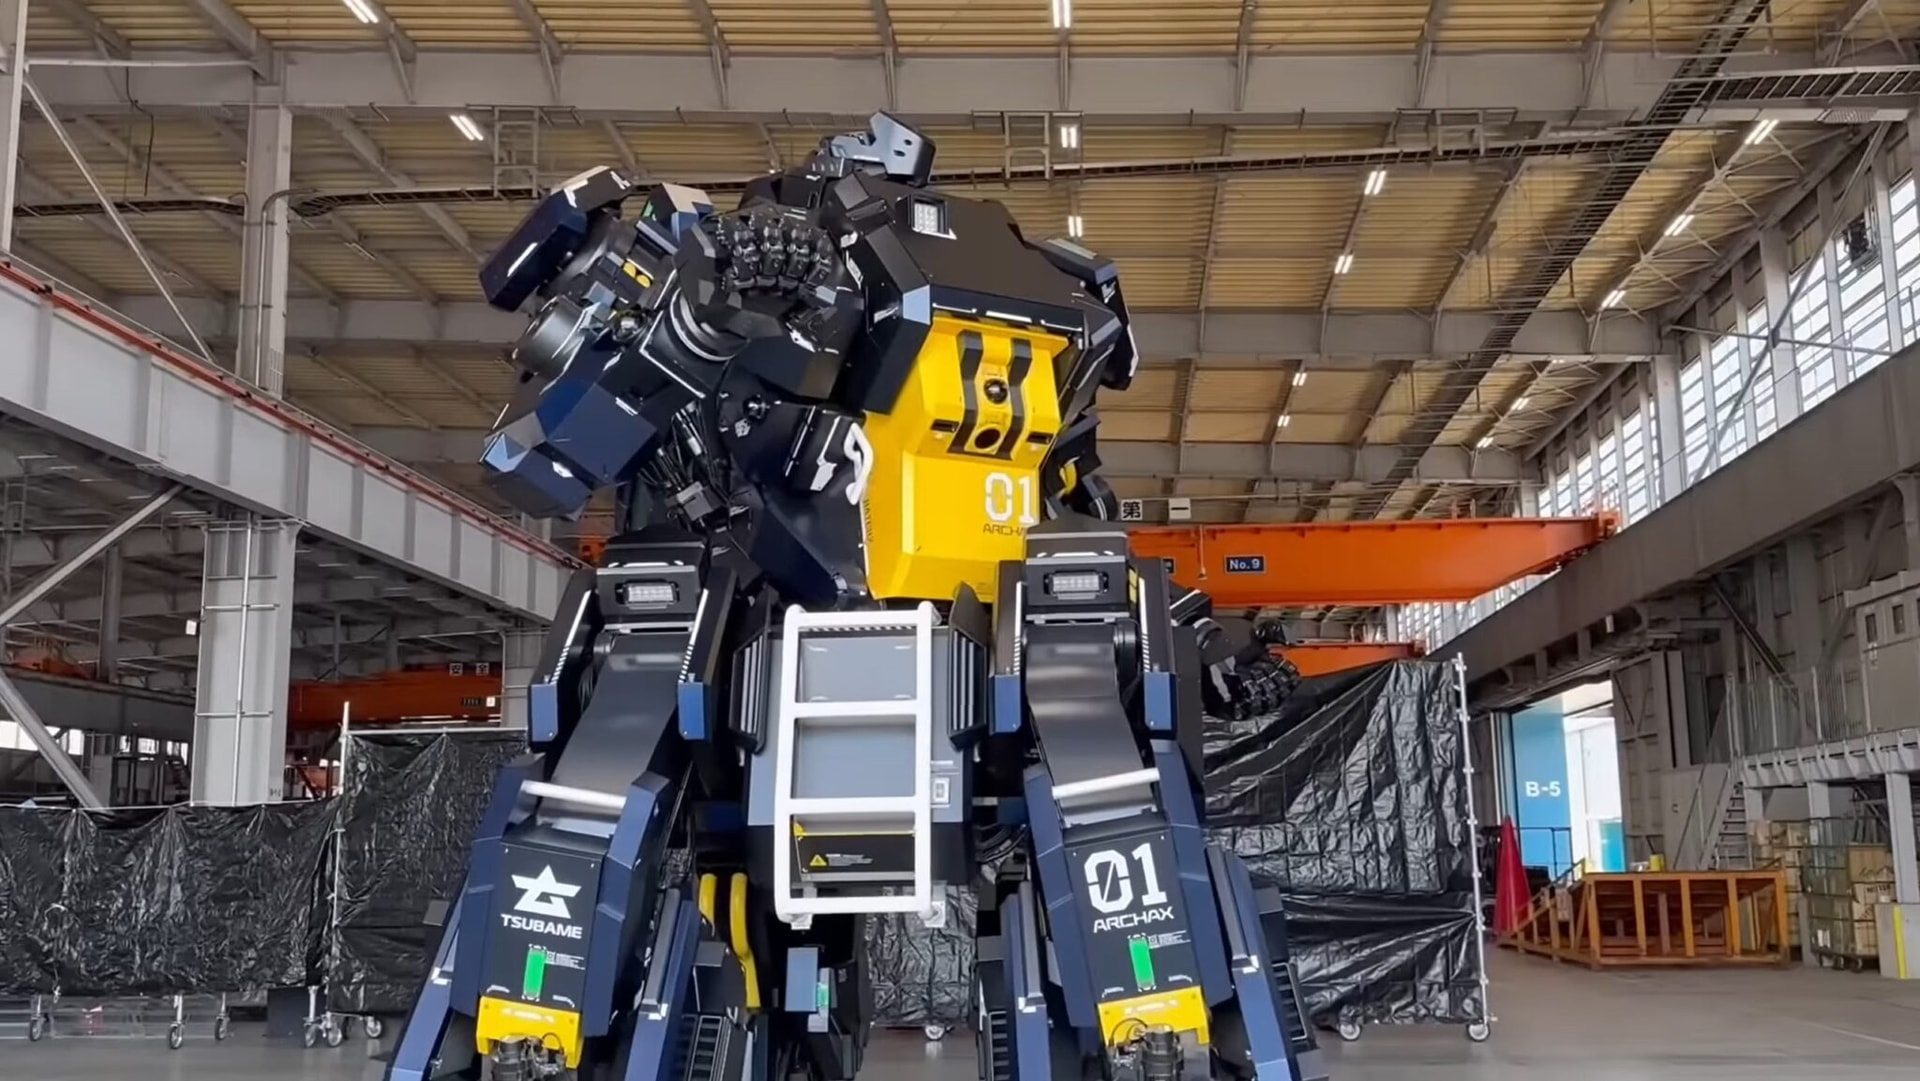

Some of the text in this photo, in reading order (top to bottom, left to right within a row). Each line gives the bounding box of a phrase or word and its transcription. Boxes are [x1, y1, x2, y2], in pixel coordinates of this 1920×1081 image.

[985, 472, 1034, 523] 01
[1526, 781, 1561, 797] B-5
[1084, 843, 1168, 913] 01
[500, 913, 583, 939] TSUBAME
[1093, 906, 1175, 933] ARCHAX
